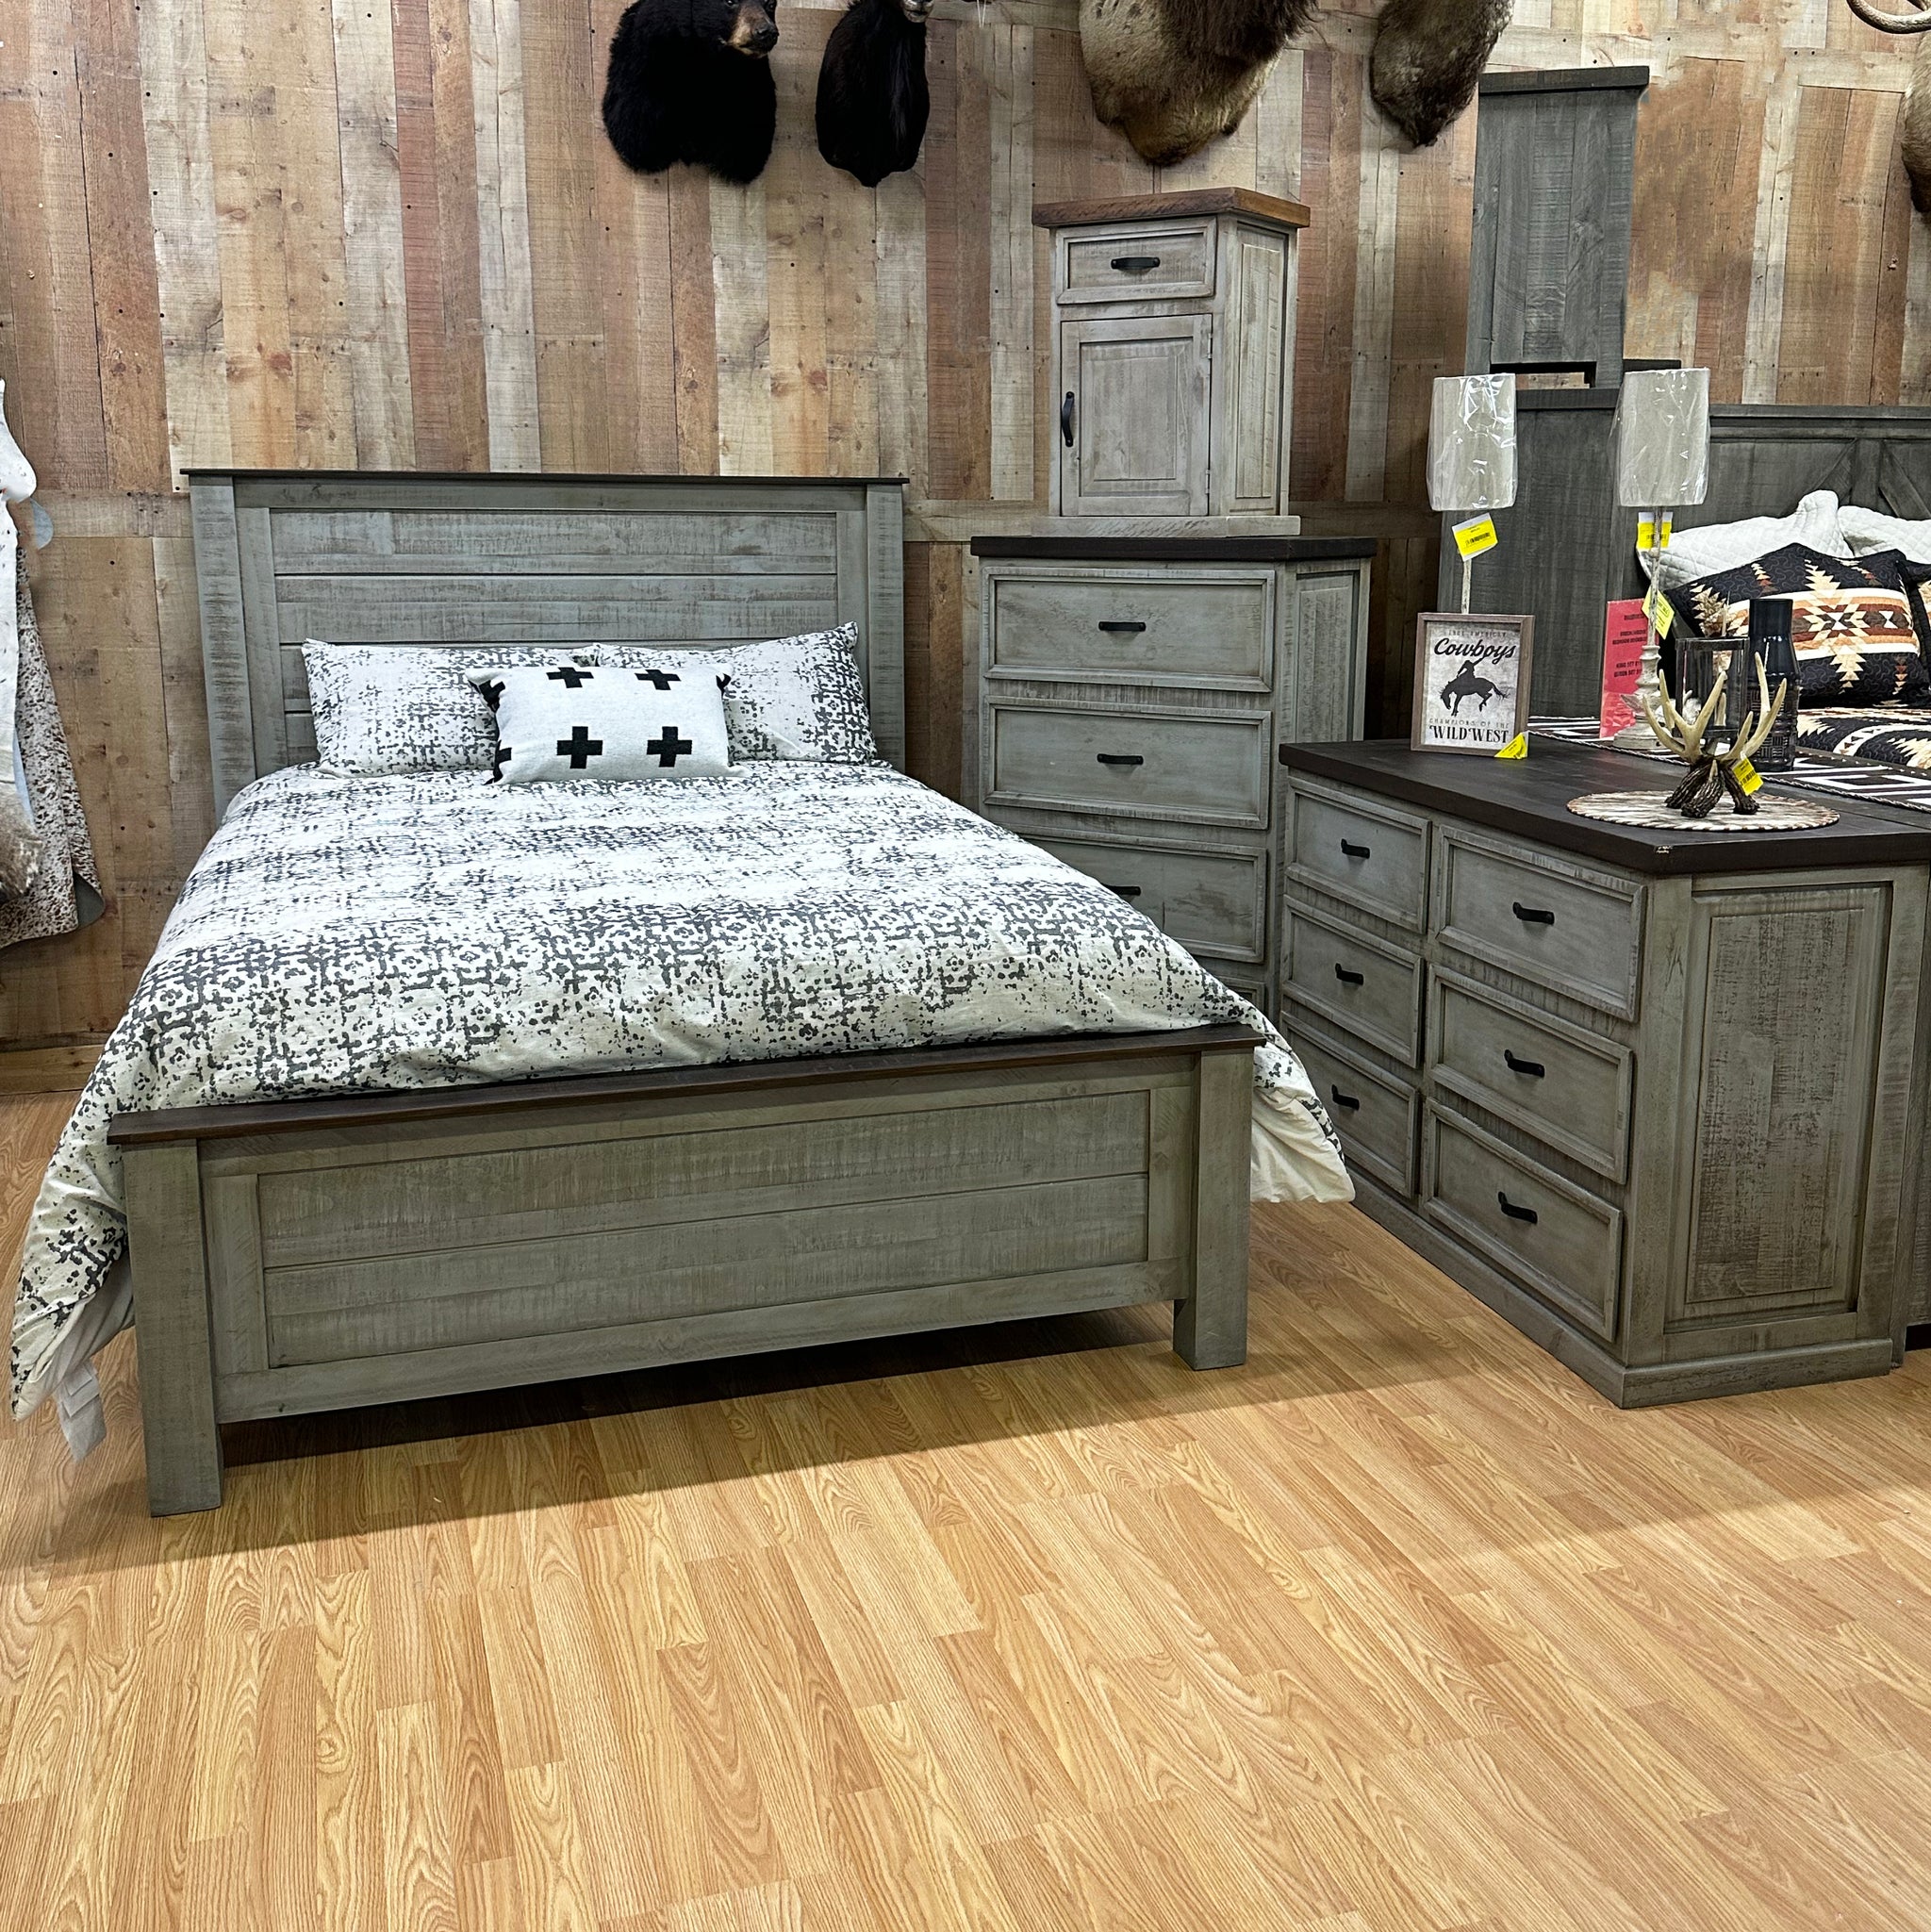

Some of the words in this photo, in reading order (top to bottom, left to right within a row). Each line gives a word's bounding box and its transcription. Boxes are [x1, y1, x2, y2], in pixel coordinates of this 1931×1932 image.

[1434, 637, 1516, 665] Cowboys
[1429, 718, 1476, 726] CHAMPIONS
[1429, 725, 1467, 740] WILD
[1468, 728, 1509, 743] WEST
